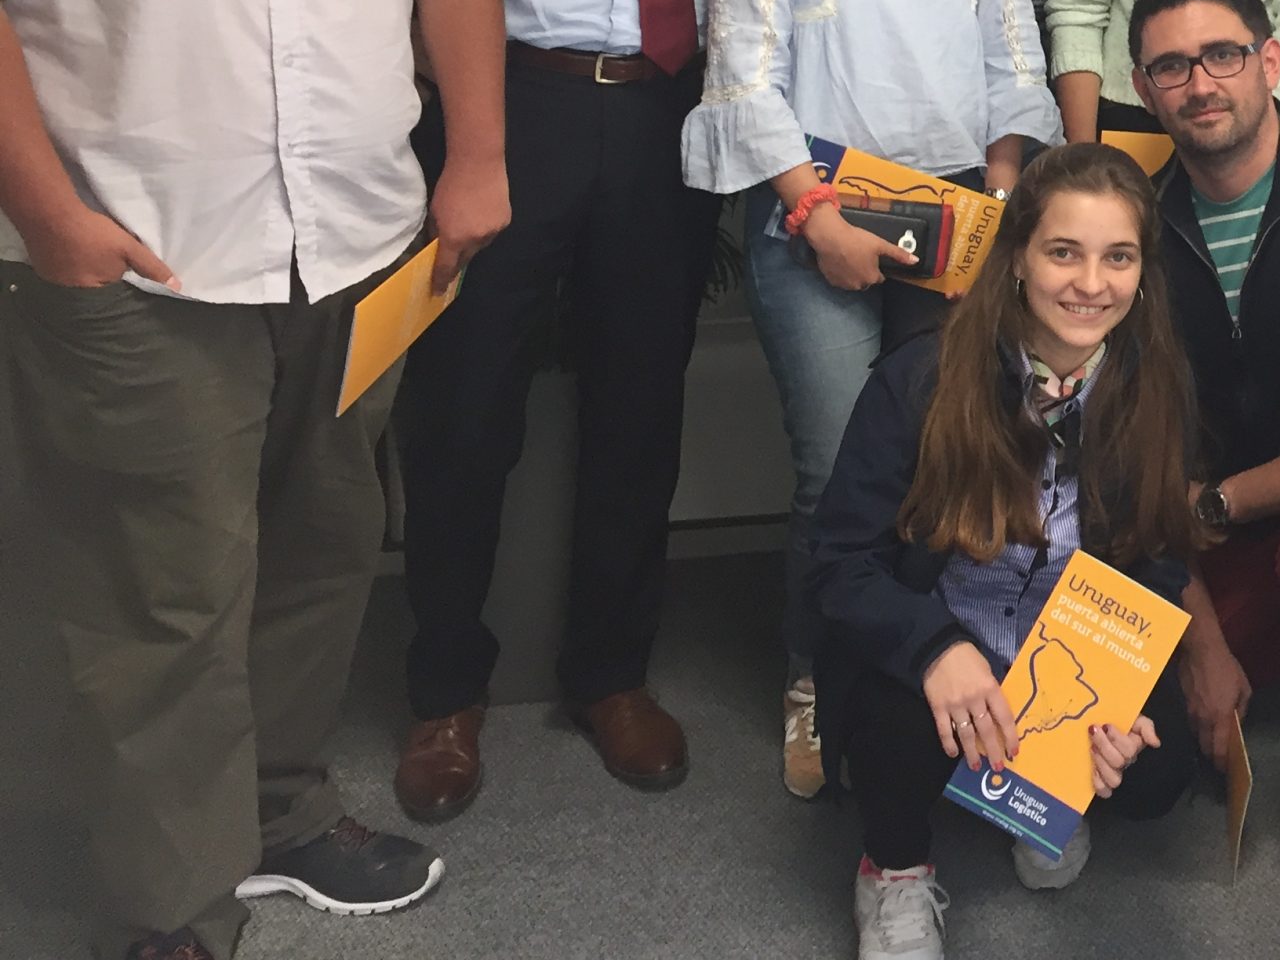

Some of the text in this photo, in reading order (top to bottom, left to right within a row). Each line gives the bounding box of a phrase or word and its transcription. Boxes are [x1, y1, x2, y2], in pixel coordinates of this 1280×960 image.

[953, 205, 998, 277] Uruguay,
[961, 198, 980, 234] puerta
[1057, 595, 1144, 650] puerta abierta
[1069, 574, 1152, 638] Uruguay,
[1050, 608, 1151, 673] del sur al mundo
[1013, 786, 1048, 814] Uruguay
